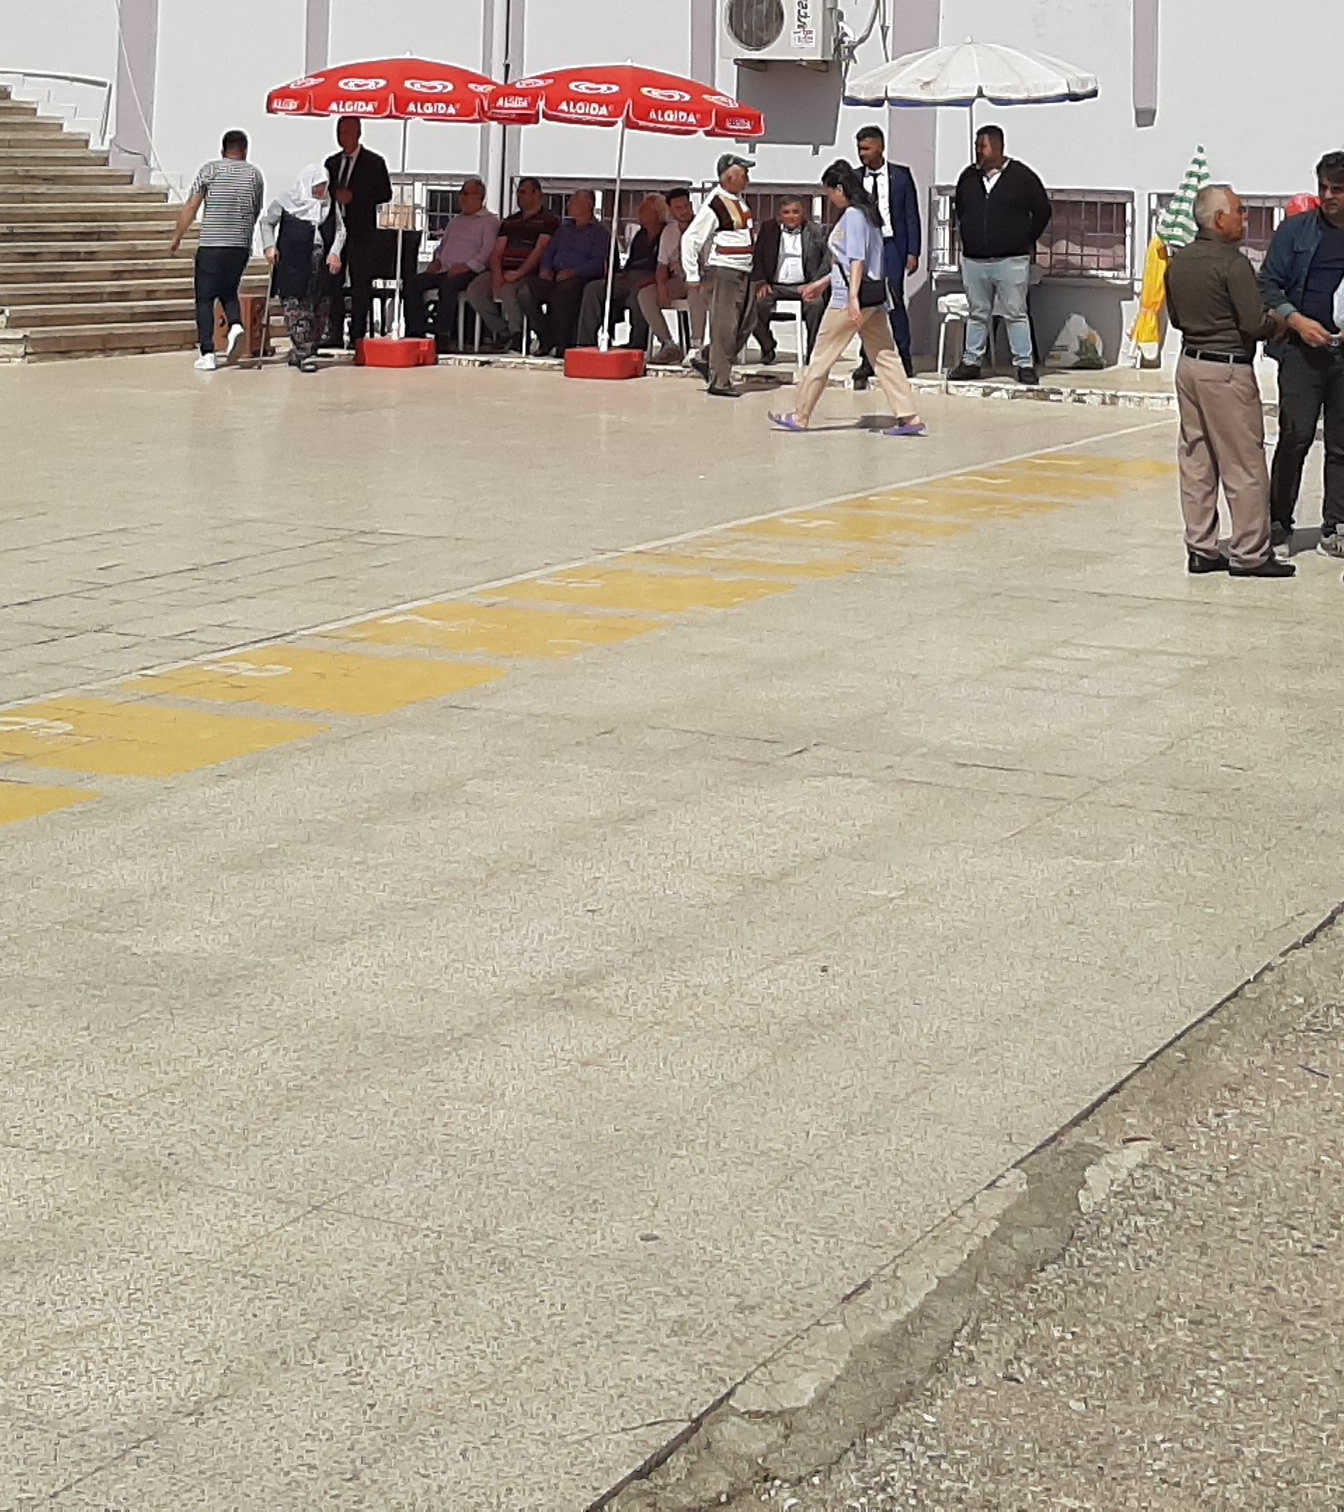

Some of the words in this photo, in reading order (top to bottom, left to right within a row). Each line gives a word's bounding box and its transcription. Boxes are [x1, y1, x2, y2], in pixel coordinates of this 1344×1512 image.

[328, 100, 377, 113] ALGIDA
[408, 101, 457, 115] ALGIDA
[557, 100, 610, 116] ALGIDA
[648, 107, 698, 124] ALGIDA
